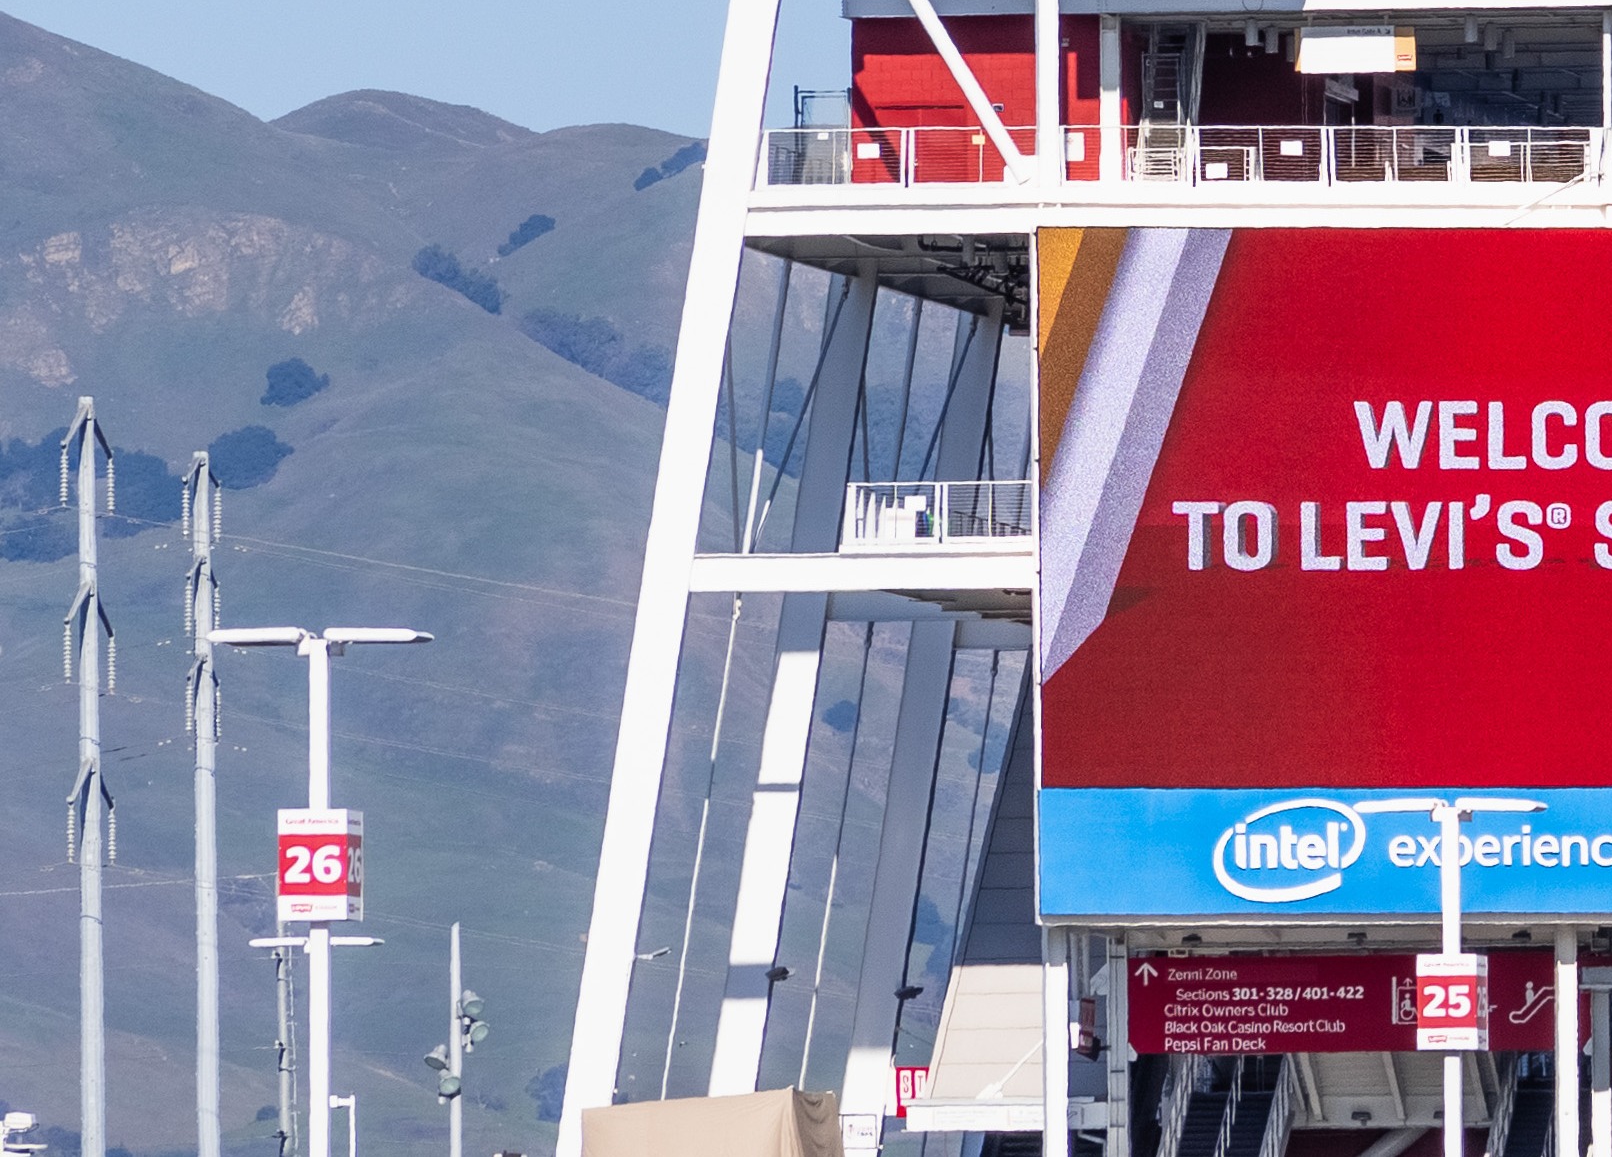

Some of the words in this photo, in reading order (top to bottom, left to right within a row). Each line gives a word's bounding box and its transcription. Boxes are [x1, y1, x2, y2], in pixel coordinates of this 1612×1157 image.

[1172, 500, 1278, 571] TO
[1234, 821, 1340, 870] intel
[284, 844, 343, 884] 26
[348, 847, 361, 884] 26
[1167, 968, 1202, 981] Zenni
[1205, 968, 1238, 980] Zone
[1176, 988, 1229, 1001] Sections
[1423, 985, 1471, 1018] 25
[1164, 1004, 1199, 1017] Citrix
[1202, 1004, 1255, 1017] Owners
[1257, 1003, 1289, 1017] Club
[1164, 1021, 1199, 1034] Black
[1201, 1021, 1227, 1034] Oak
[1228, 1020, 1272, 1034] Casino
[1273, 1020, 1315, 1033] Resort
[1316, 1020, 1346, 1033] Club
[1164, 1037, 1201, 1053] Pepsi
[1204, 1037, 1229, 1051] Fan
[1232, 1037, 1266, 1051] Deck
